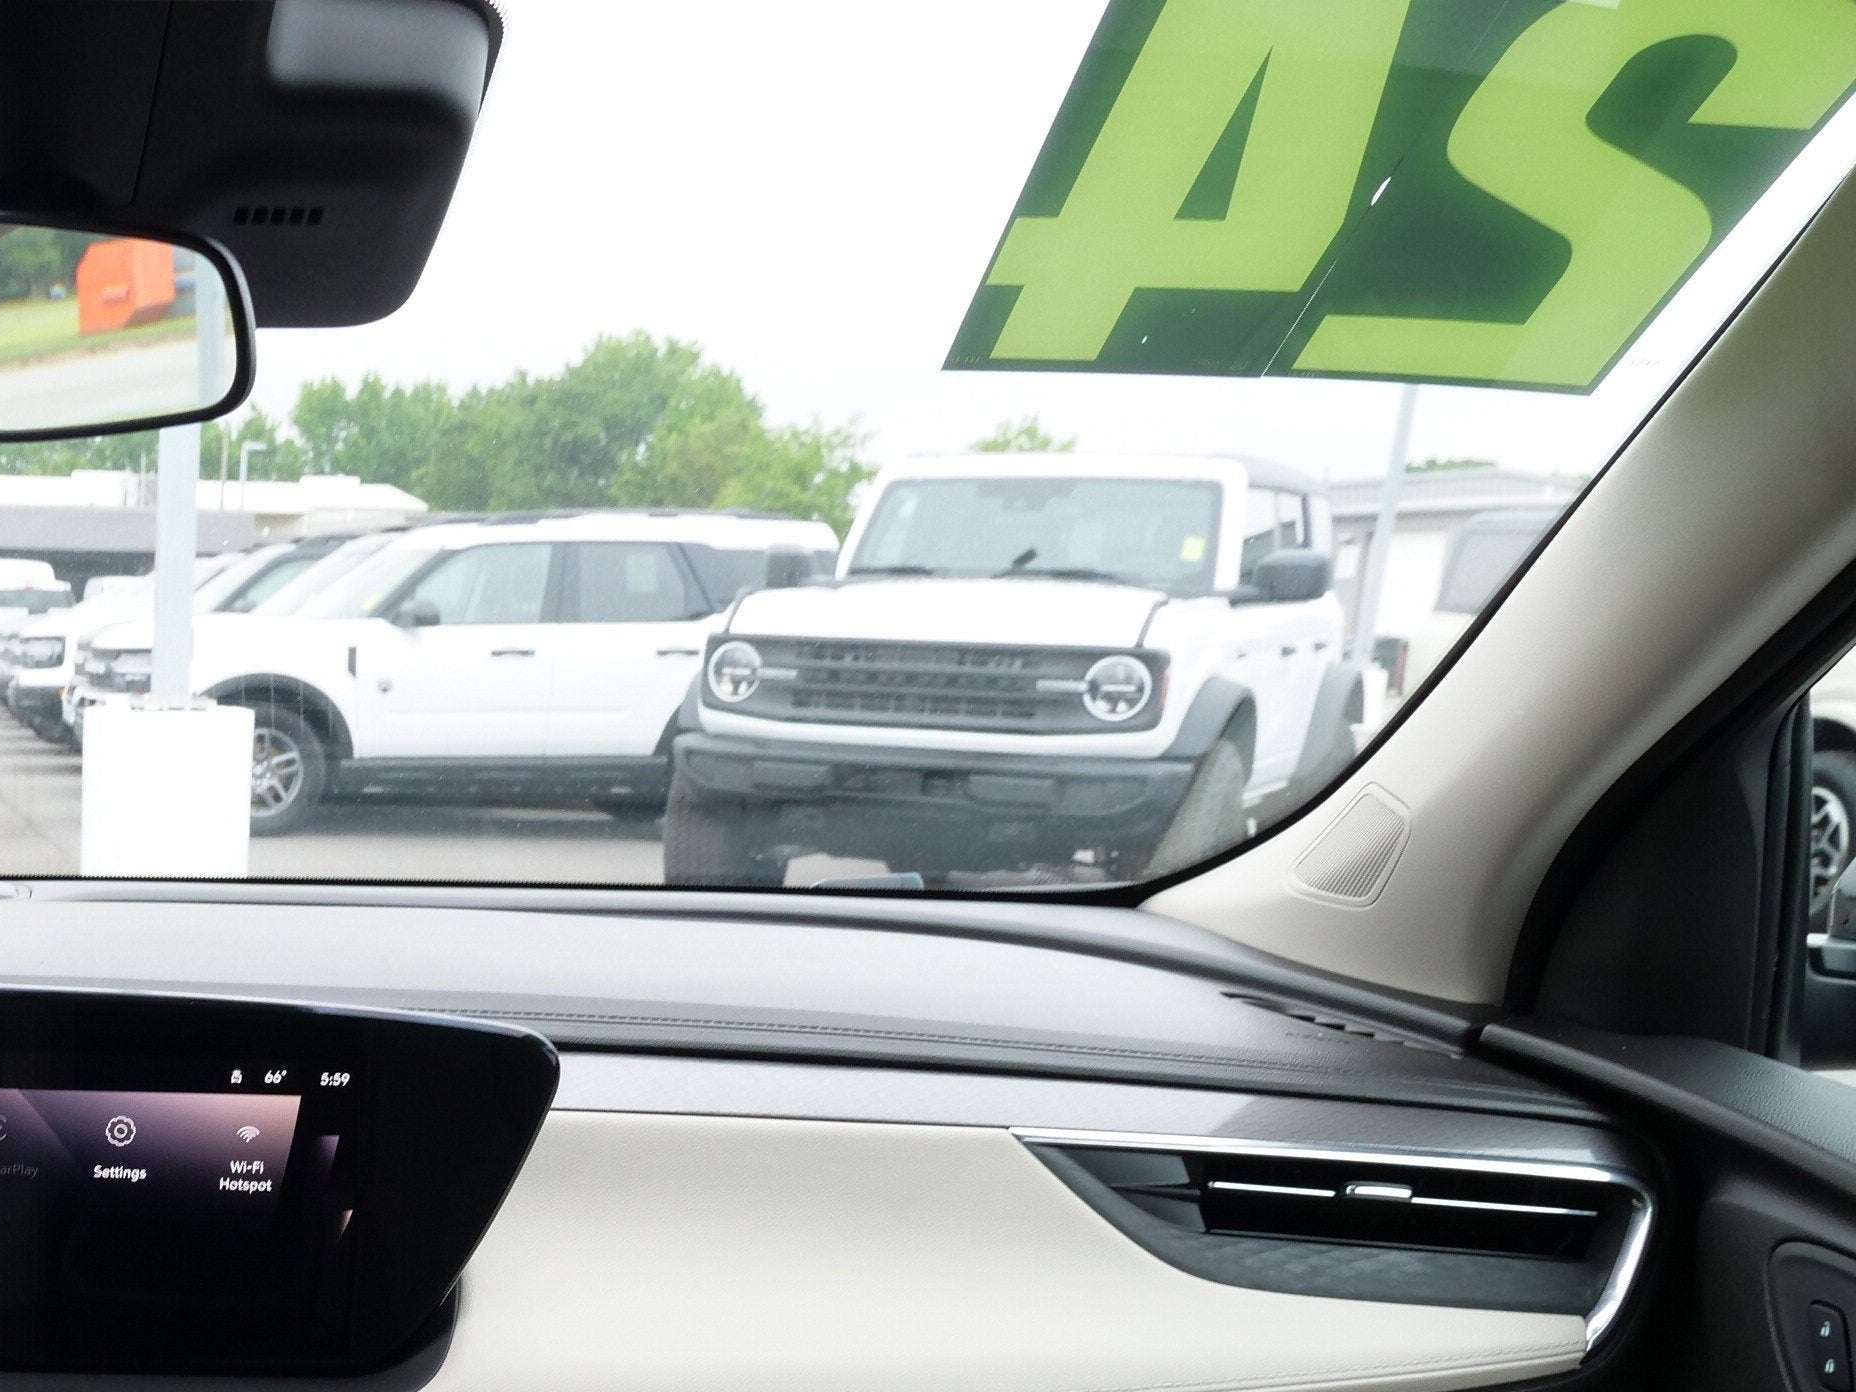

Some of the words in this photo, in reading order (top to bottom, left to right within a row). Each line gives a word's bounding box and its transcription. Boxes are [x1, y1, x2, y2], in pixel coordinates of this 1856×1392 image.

[320, 1072, 351, 1087] 5:59
[93, 1164, 148, 1183] Settings
[229, 1160, 265, 1175] Wi-Fi
[218, 1176, 273, 1195] Hotspot
